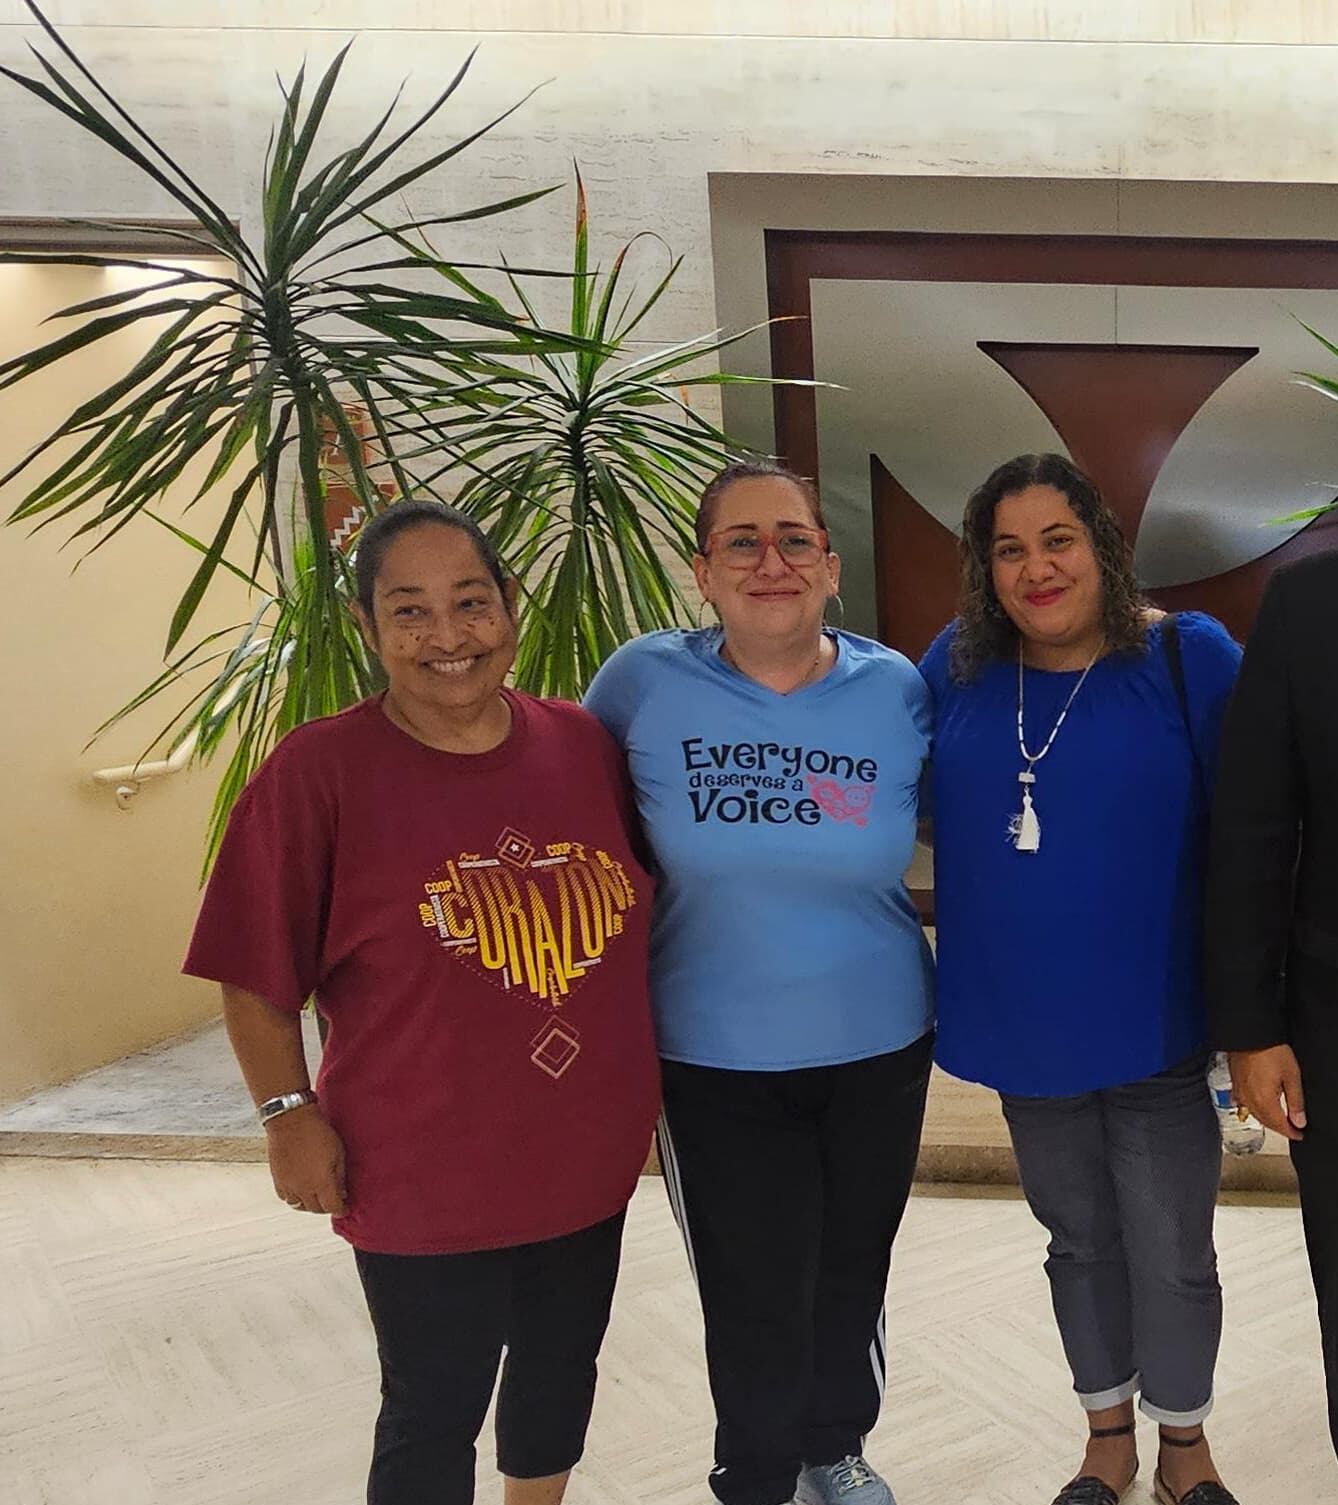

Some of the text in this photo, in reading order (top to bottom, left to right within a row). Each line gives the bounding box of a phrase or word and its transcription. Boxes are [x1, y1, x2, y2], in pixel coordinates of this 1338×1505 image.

[681, 737, 878, 783] Everyone
[689, 771, 804, 792] deserves a
[687, 788, 822, 825] Voice
[424, 880, 452, 894] COOP
[418, 903, 437, 928] COOP
